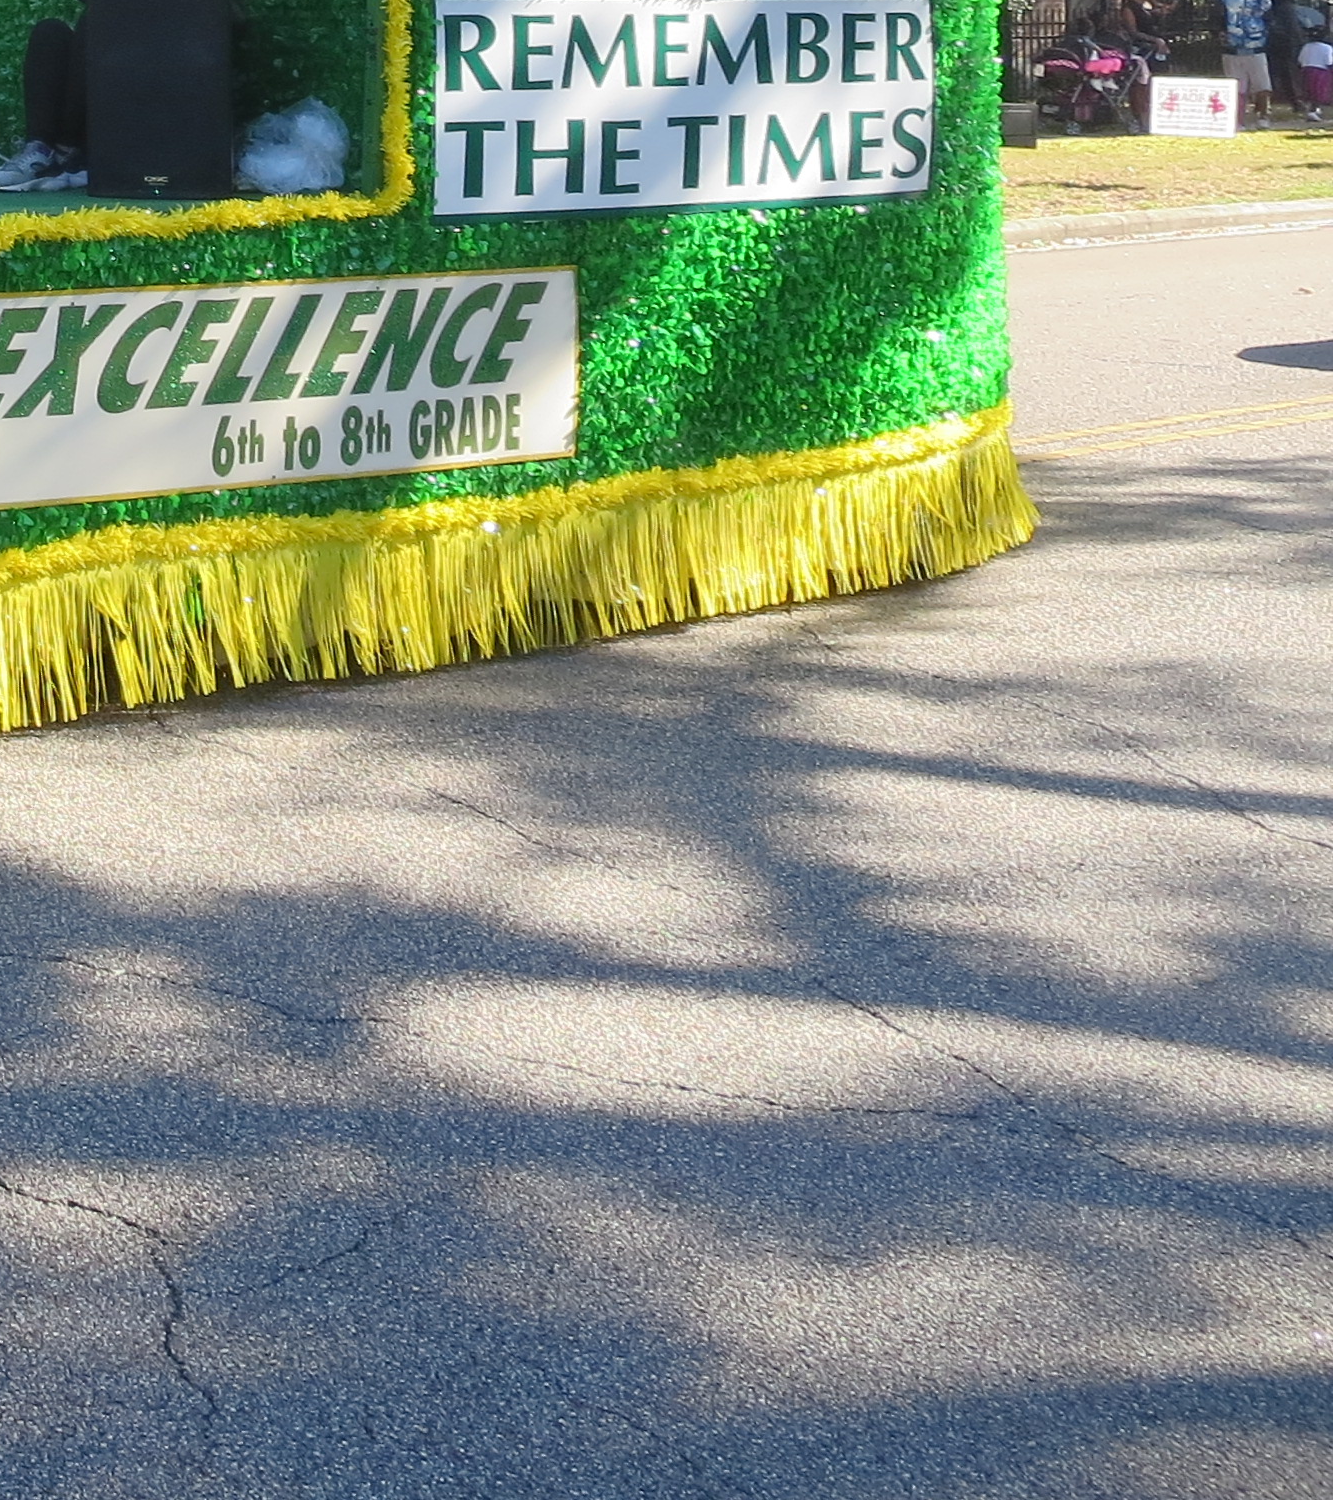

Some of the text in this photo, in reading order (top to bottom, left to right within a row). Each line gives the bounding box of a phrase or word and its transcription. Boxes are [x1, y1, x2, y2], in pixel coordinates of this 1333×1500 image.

[443, 11, 926, 92] REMEMBER
[444, 107, 928, 199] THE TIMES
[211, 414, 264, 478] 6th
[282, 415, 322, 471] to
[340, 405, 392, 466] 8th
[408, 393, 522, 460] GRADE
